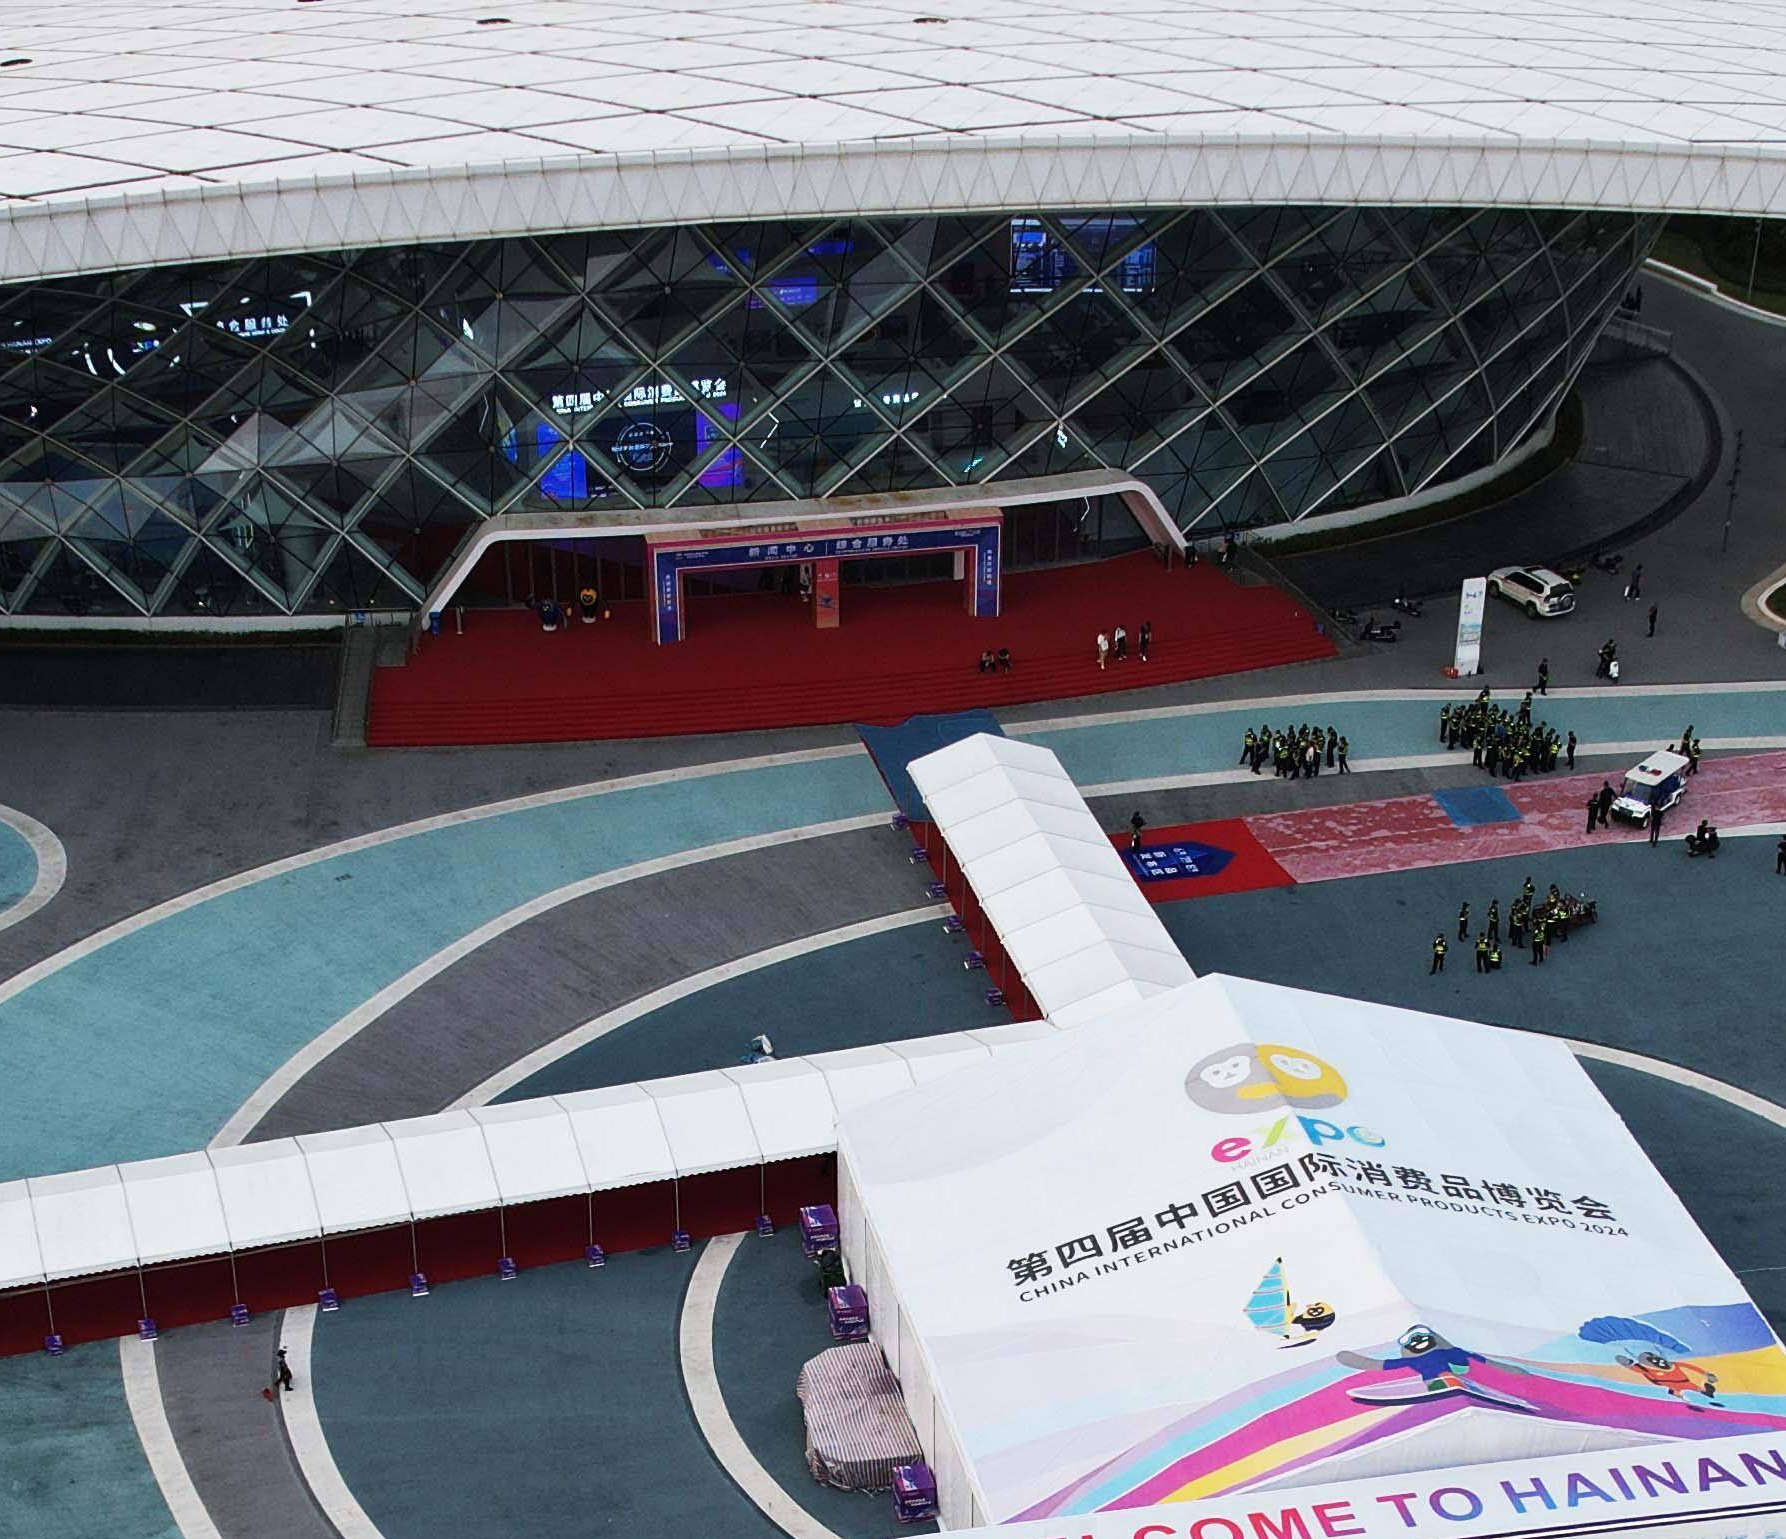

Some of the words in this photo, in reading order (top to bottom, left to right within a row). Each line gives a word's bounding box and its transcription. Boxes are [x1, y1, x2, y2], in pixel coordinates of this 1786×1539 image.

[1211, 1115, 1386, 1164] expo
[1007, 1153, 1617, 1286] 第四届中国国际消费品博览会
[1019, 1271, 1092, 1302] CHINA
[1095, 1207, 1276, 1277] INTERNATIONAL
[1281, 1182, 1403, 1213] CONSUMER
[1407, 1194, 1518, 1222] PRODUCTS
[1522, 1212, 1577, 1231] EXPO
[1578, 1221, 1629, 1239] 2024
[1376, 1484, 1483, 1530] TO
